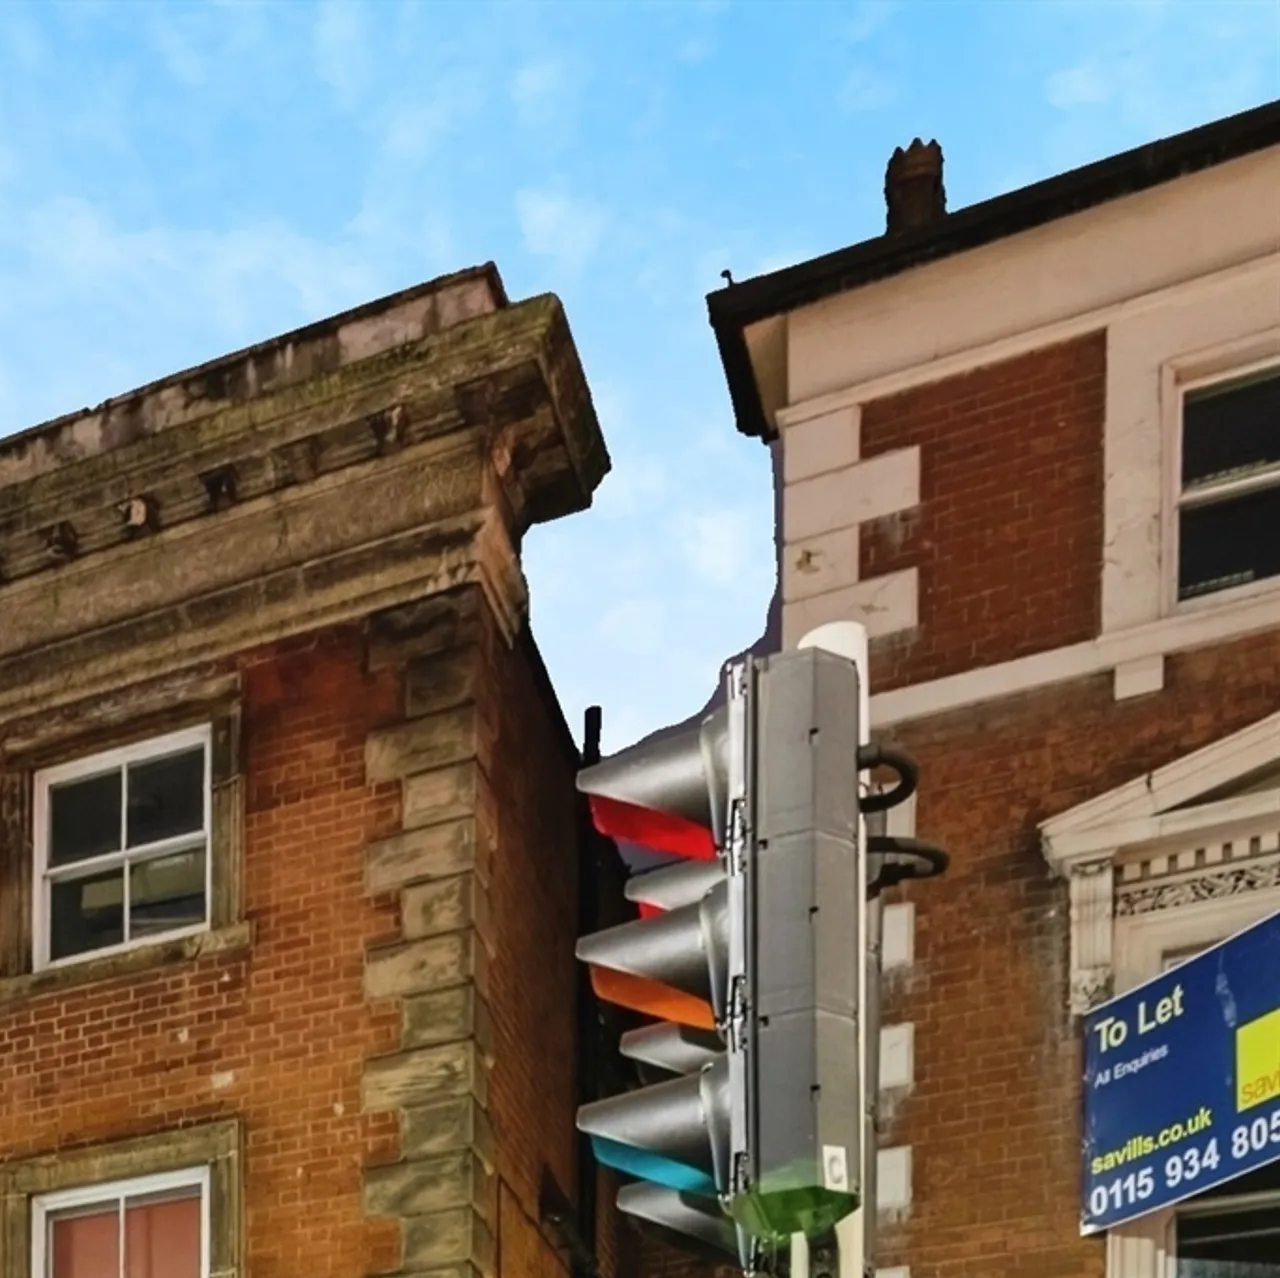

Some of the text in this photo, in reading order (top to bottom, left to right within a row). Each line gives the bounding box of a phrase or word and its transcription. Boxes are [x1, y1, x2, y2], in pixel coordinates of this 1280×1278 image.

[1094, 984, 1184, 1053] To Let
[1094, 1044, 1168, 1089] All Enquiries
[1091, 1106, 1212, 1175] savills.co.uk
[1090, 1166, 1155, 1216] 0115
[1165, 1137, 1220, 1188] 934
